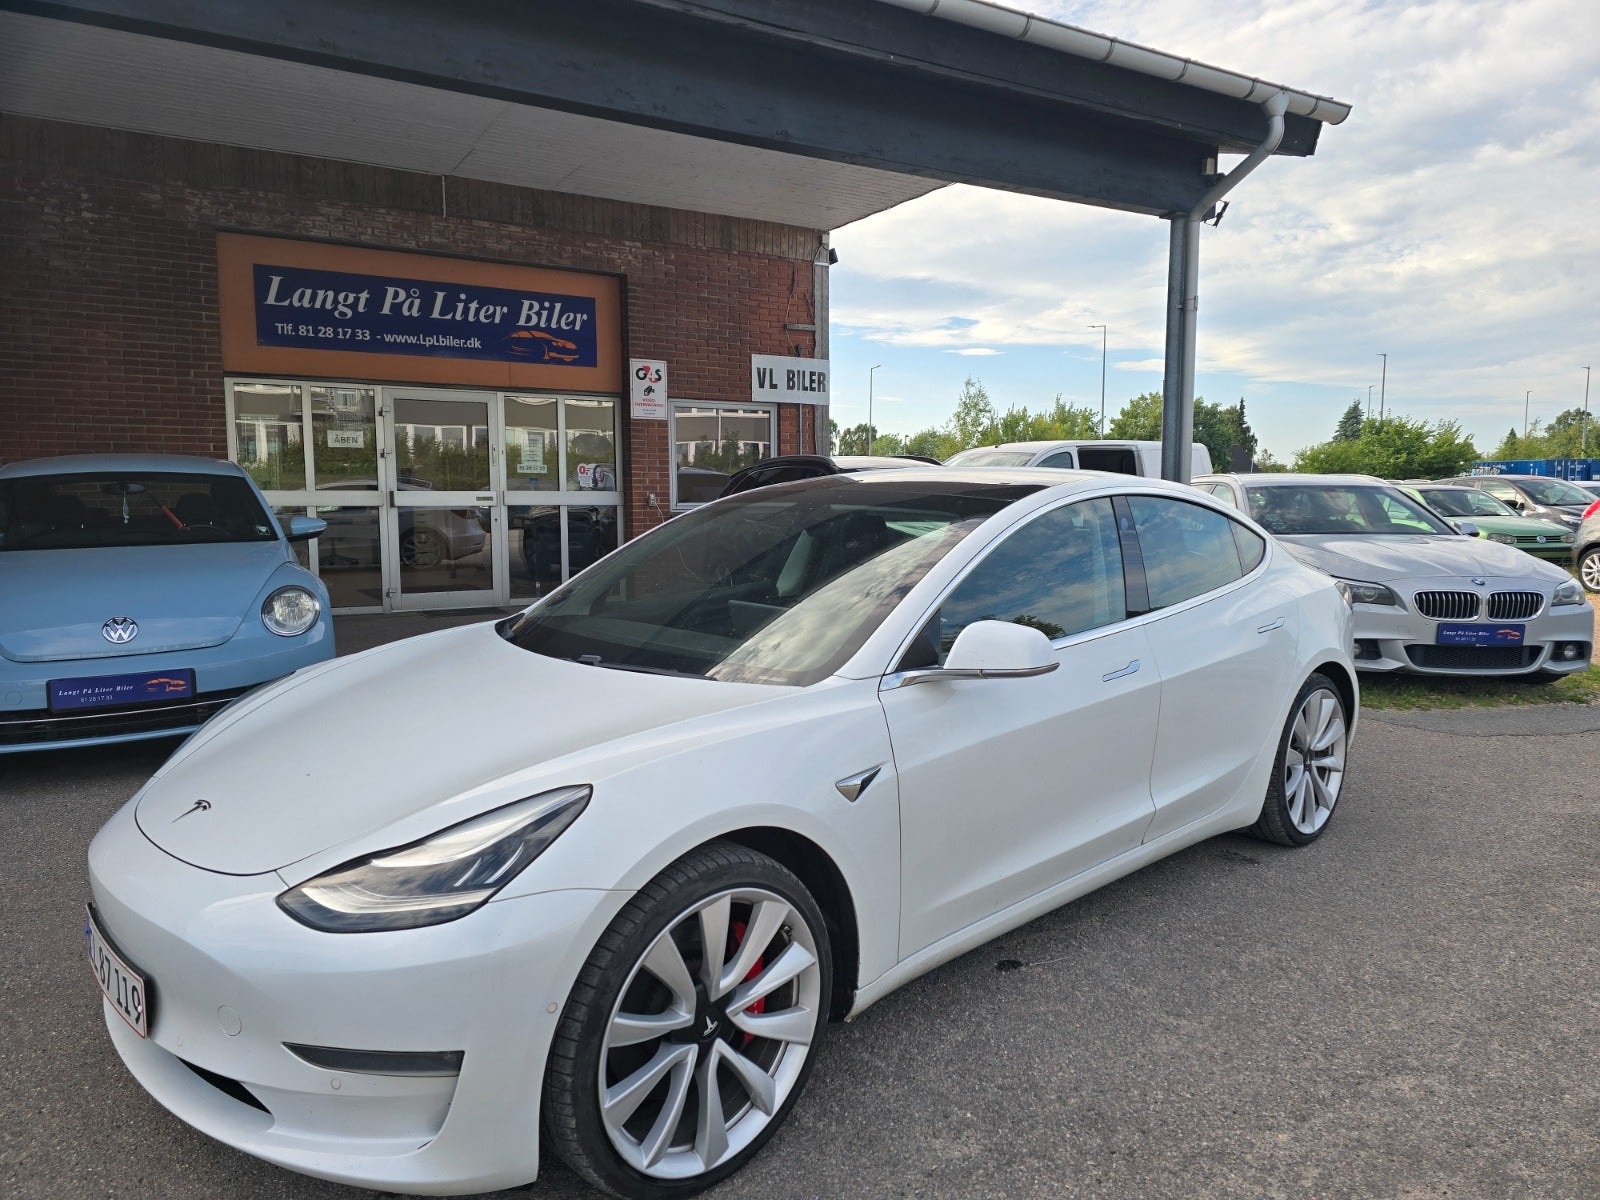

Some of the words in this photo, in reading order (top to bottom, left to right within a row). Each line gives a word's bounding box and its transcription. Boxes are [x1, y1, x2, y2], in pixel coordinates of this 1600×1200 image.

[264, 275, 370, 319] Langt
[379, 286, 422, 317] På
[429, 290, 508, 324] Liter
[516, 299, 588, 331] Biler
[275, 322, 296, 336] Tlf.
[298, 325, 315, 337] 81
[317, 326, 334, 338] 28
[336, 328, 352, 339] 17
[355, 329, 371, 341] 33
[383, 332, 482, 349] www.LpLbiler.dk
[756, 367, 778, 390] VL
[786, 369, 827, 393] BILER
[334, 433, 359, 444] ÅBEN
[99, 946, 111, 990] 87
[114, 968, 142, 1024] 119
